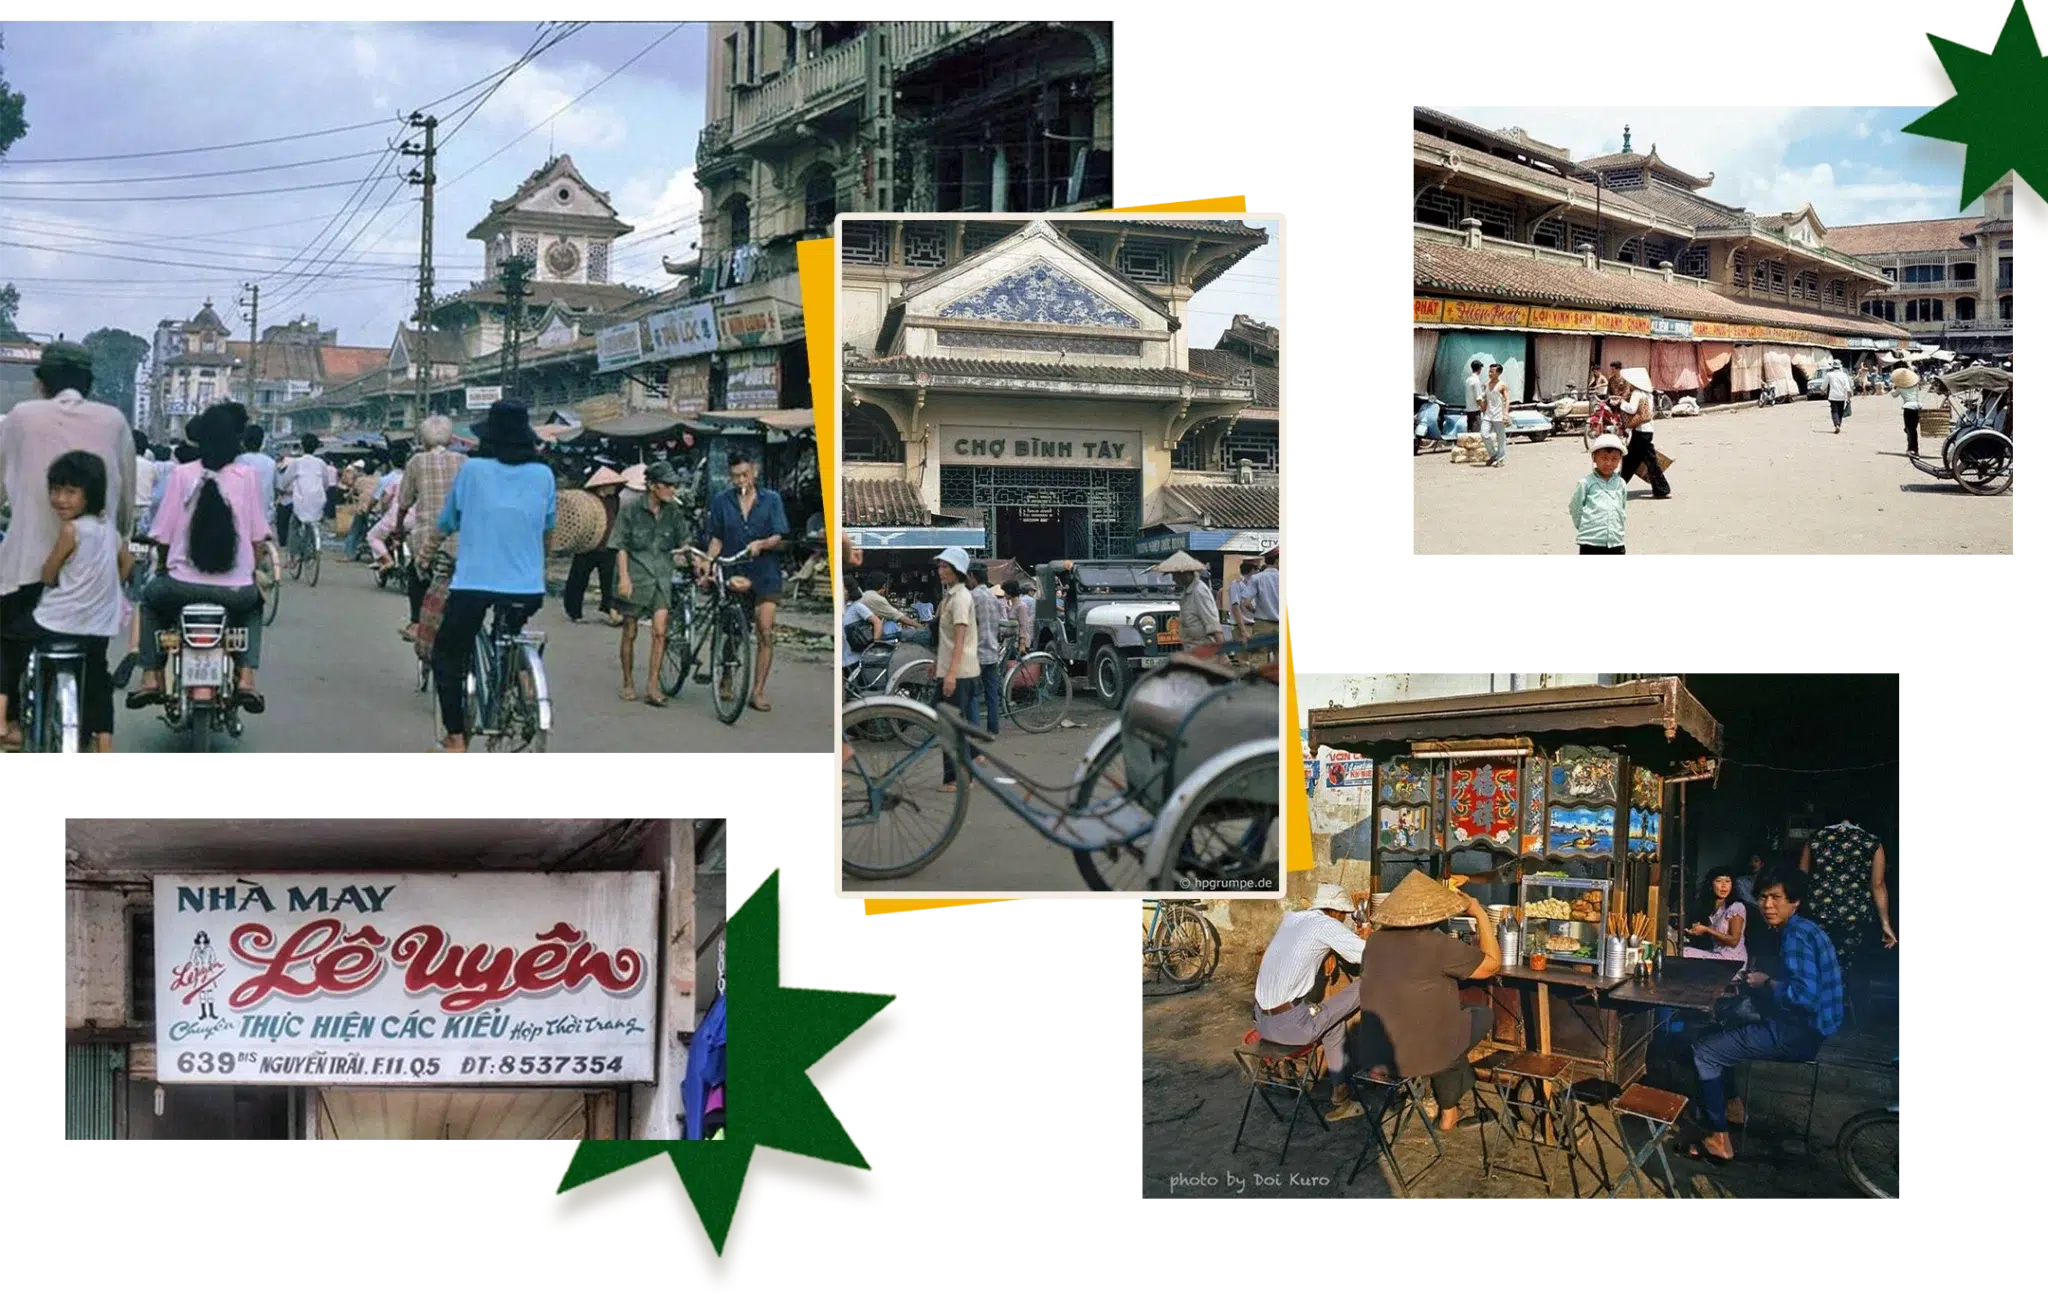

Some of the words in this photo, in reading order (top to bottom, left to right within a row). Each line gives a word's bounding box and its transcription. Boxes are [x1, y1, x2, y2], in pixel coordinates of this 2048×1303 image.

[954, 438, 1006, 459] CHỢ
[1015, 437, 1073, 457] BÌNH
[1083, 440, 1126, 459] TÂY
[177, 878, 277, 913] NHÀ
[287, 885, 396, 913] MAY
[228, 918, 386, 1009] Lê
[391, 921, 642, 1013] Uyên
[168, 1018, 235, 1041] Chuyên
[239, 1011, 304, 1042] THỰC
[310, 1011, 376, 1042] HIỆN
[381, 1009, 436, 1039] CÁC
[441, 1007, 511, 1039] KIỂU
[509, 1020, 543, 1042] Hợp
